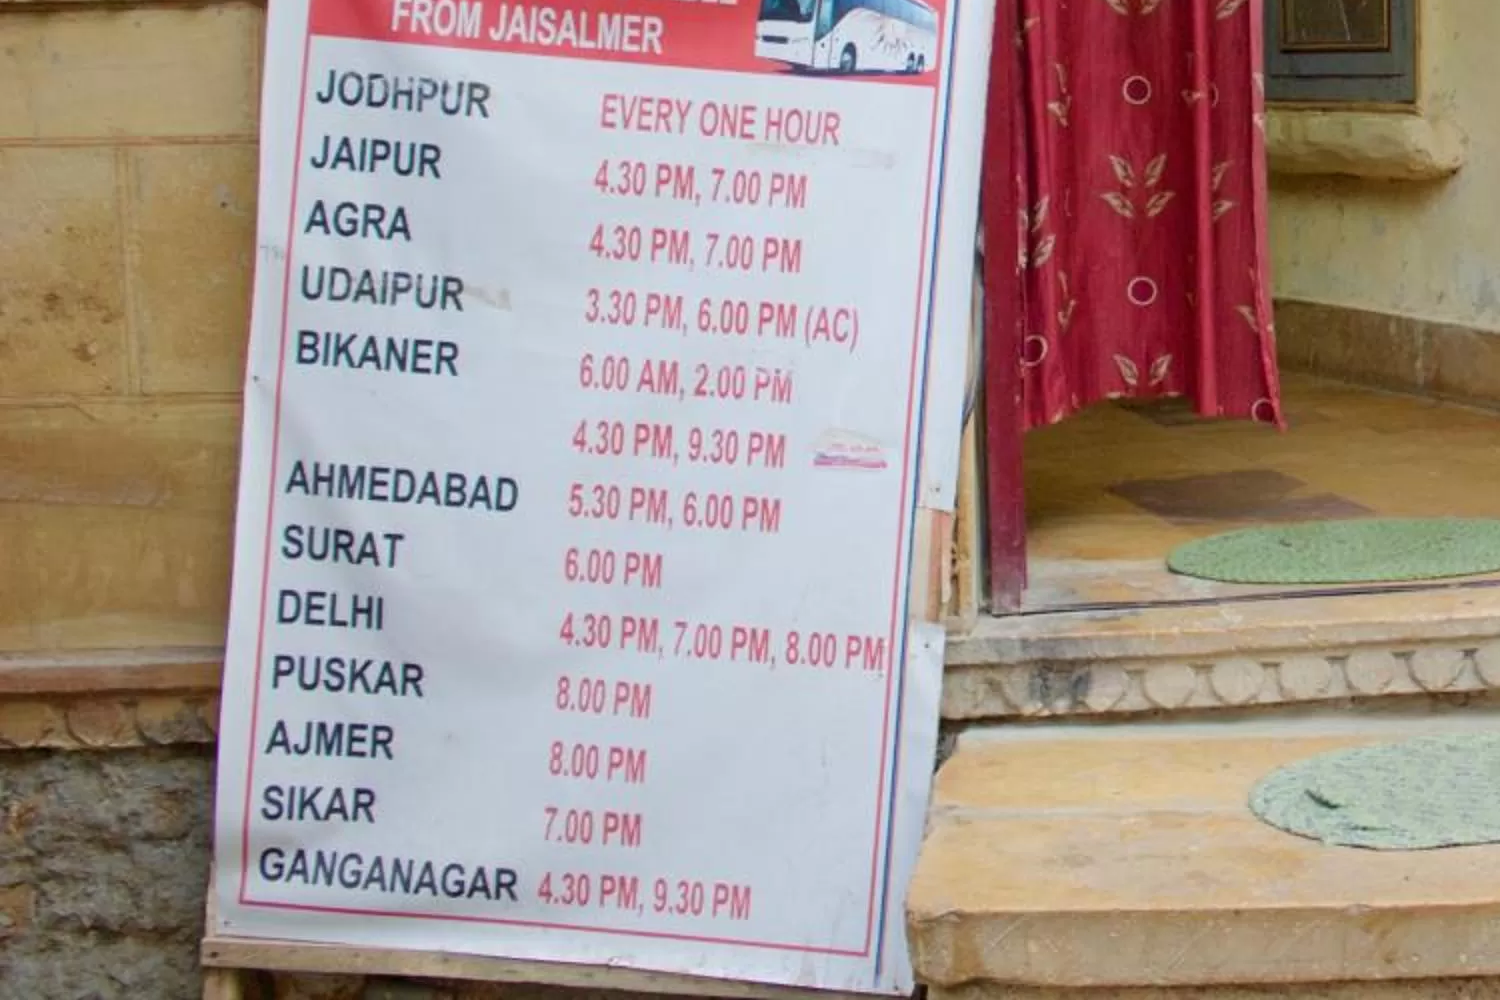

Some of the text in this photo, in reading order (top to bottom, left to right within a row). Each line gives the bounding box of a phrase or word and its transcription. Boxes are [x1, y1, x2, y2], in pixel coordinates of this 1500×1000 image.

[488, 3, 663, 53] JAISALMER
[315, 69, 841, 145] JODHPUR EVERY ONE HOUR
[310, 135, 807, 210] JAIPUR 4.30 PM, 7.00 PM
[304, 199, 802, 274] AGRA 4.30 PM, 7.00 PM
[301, 265, 860, 353] UDAIPUR 3.30 PM, 6.00 PM (AC)
[295, 329, 792, 404] BIKANER 6.00 AM, 2.00 PM
[572, 419, 786, 469] 4.30 PM, 9.30 PM
[286, 460, 781, 533] AHMEDABAD 5.30 PM, 6.00 PM
[282, 524, 663, 590] SURAT 6.00 PM
[277, 590, 885, 672] DELHI 4.30 PM, 7.00 PM, 8.00 PM
[272, 655, 652, 719] PUSKAR 8.00 PM
[265, 720, 647, 784] AJMER 8.00 PM
[261, 786, 642, 848] SIKAR 7.00 PM
[259, 848, 751, 920] GANGANAGAR 4.30 PM, 9.30 PM
